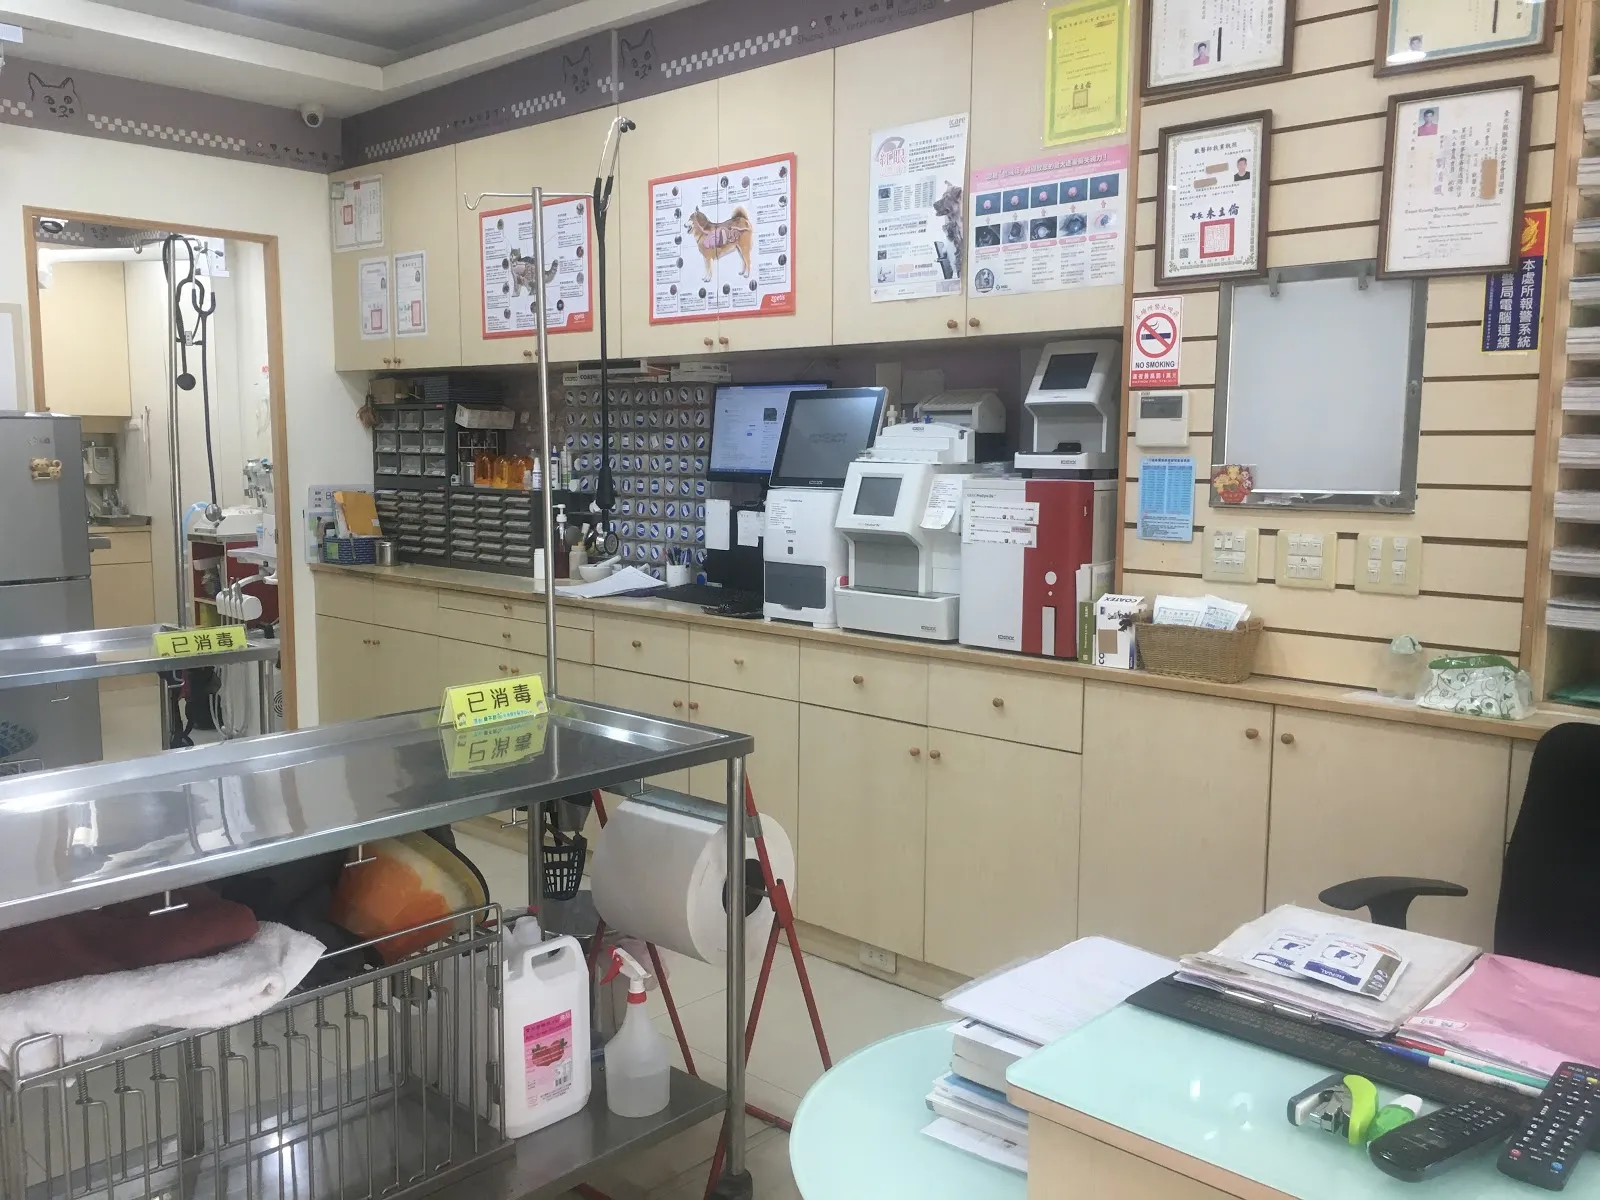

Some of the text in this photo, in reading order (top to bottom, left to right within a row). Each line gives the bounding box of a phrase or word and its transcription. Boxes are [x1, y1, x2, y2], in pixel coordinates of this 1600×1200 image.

[1516, 259, 1536, 348] 本處所報警系統
[1135, 360, 1175, 369] NO SMOKING
[170, 632, 233, 654] 已消毒
[466, 684, 532, 713] 已消毒
[1319, 968, 1346, 981] RENAL
